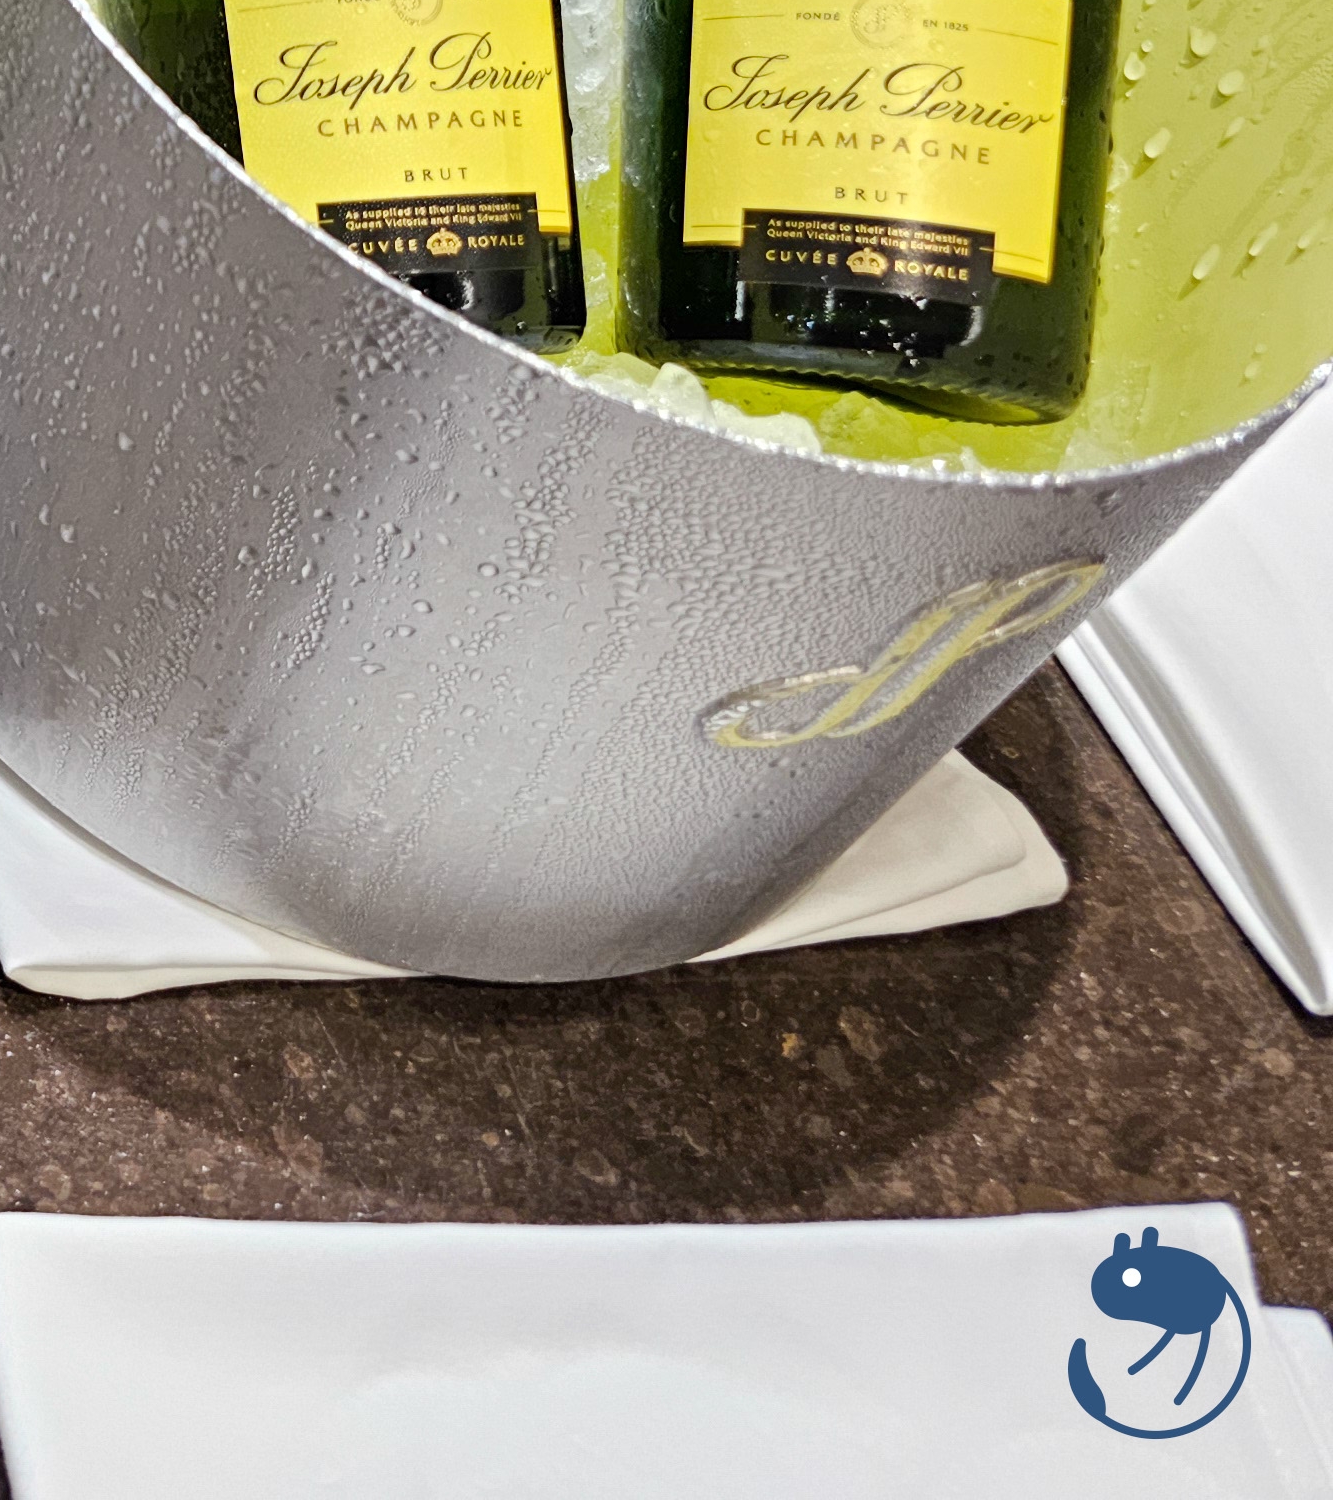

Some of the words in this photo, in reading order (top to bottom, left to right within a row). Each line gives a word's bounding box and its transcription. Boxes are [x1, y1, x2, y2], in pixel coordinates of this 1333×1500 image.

[796, 10, 840, 22] FONDÉ
[923, 18, 938, 29] EN
[944, 20, 969, 32] 1825
[253, 39, 417, 111] Joseph
[428, 31, 553, 92] Perrier
[703, 54, 871, 123] Joseph
[880, 62, 1054, 134] Perrier
[318, 109, 523, 137] CHAMPAGNE
[756, 128, 991, 165] CHAMPAGNE
[404, 167, 468, 183] BRUT
[835, 187, 908, 205] BRUT
[468, 234, 525, 248] ROYALE
[767, 228, 803, 238] Queen
[807, 230, 851, 242] Victoria
[855, 235, 876, 245] and
[881, 236, 906, 249] King
[911, 241, 951, 254] Edward
[953, 246, 968, 256] VII
[768, 218, 782, 228] As
[786, 220, 835, 233] supplied
[840, 223, 851, 232] to
[855, 224, 884, 235] their
[888, 227, 909, 238] late
[914, 231, 969, 246] majesties
[766, 249, 838, 265] CUVÉE
[894, 260, 969, 281] ROYALE
